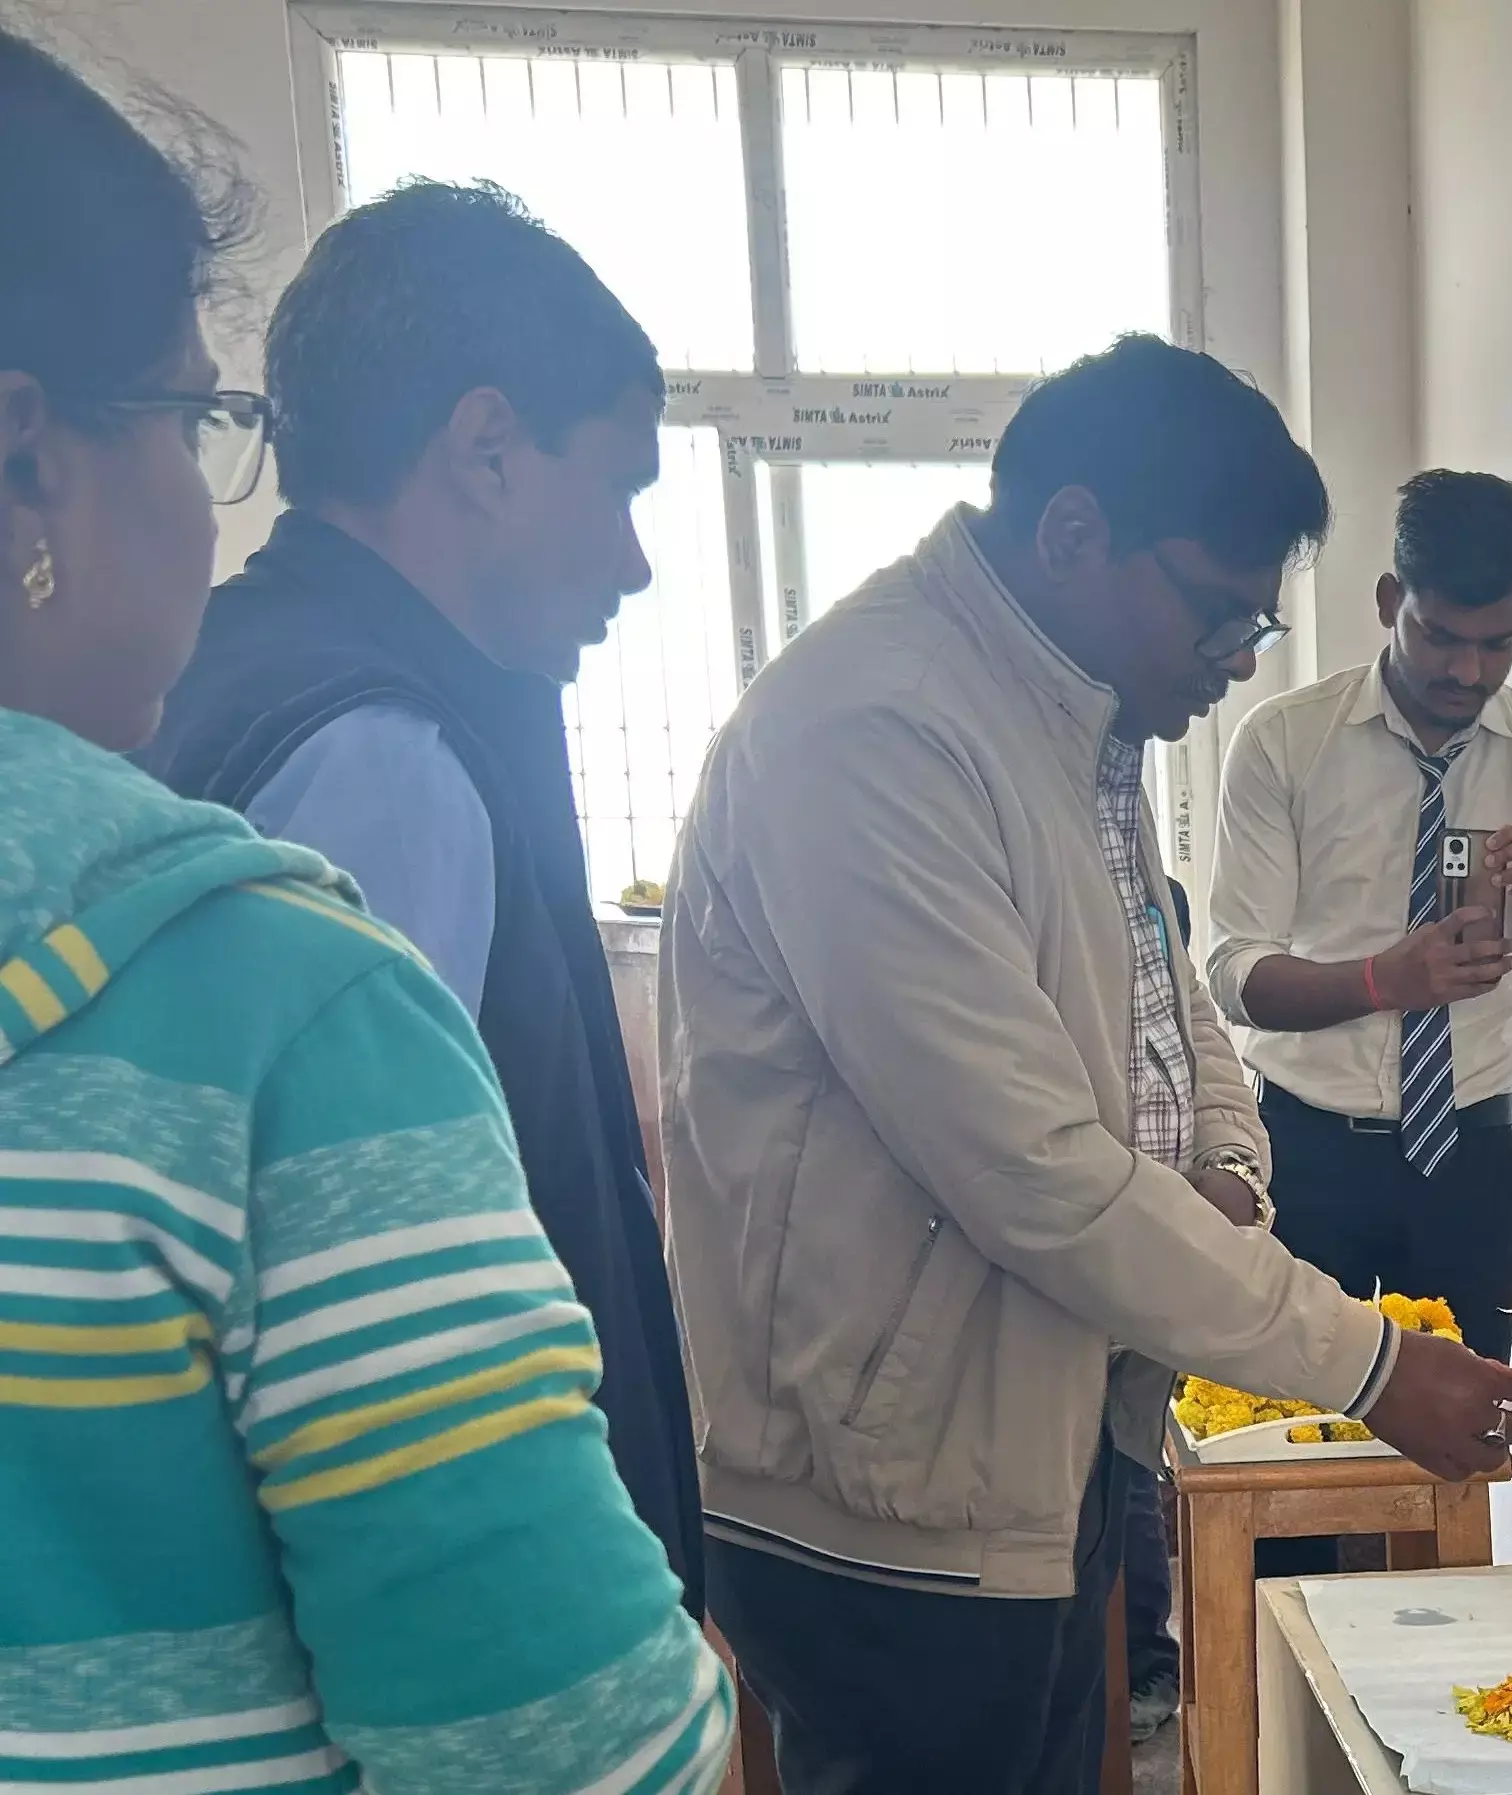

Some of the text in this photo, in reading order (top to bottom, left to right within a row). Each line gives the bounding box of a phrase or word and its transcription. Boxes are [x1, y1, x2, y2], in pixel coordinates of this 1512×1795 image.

[667, 380, 702, 395] strix
[852, 383, 951, 399] SIMTA Astrix
[793, 407, 893, 425] SIMTA Astrix
[769, 436, 803, 451] SIMTA
[949, 437, 993, 452] Astrix
[783, 587, 799, 621] SIMTA
[739, 627, 754, 661] SIMTA
[1178, 830, 1191, 863] SIMTA
